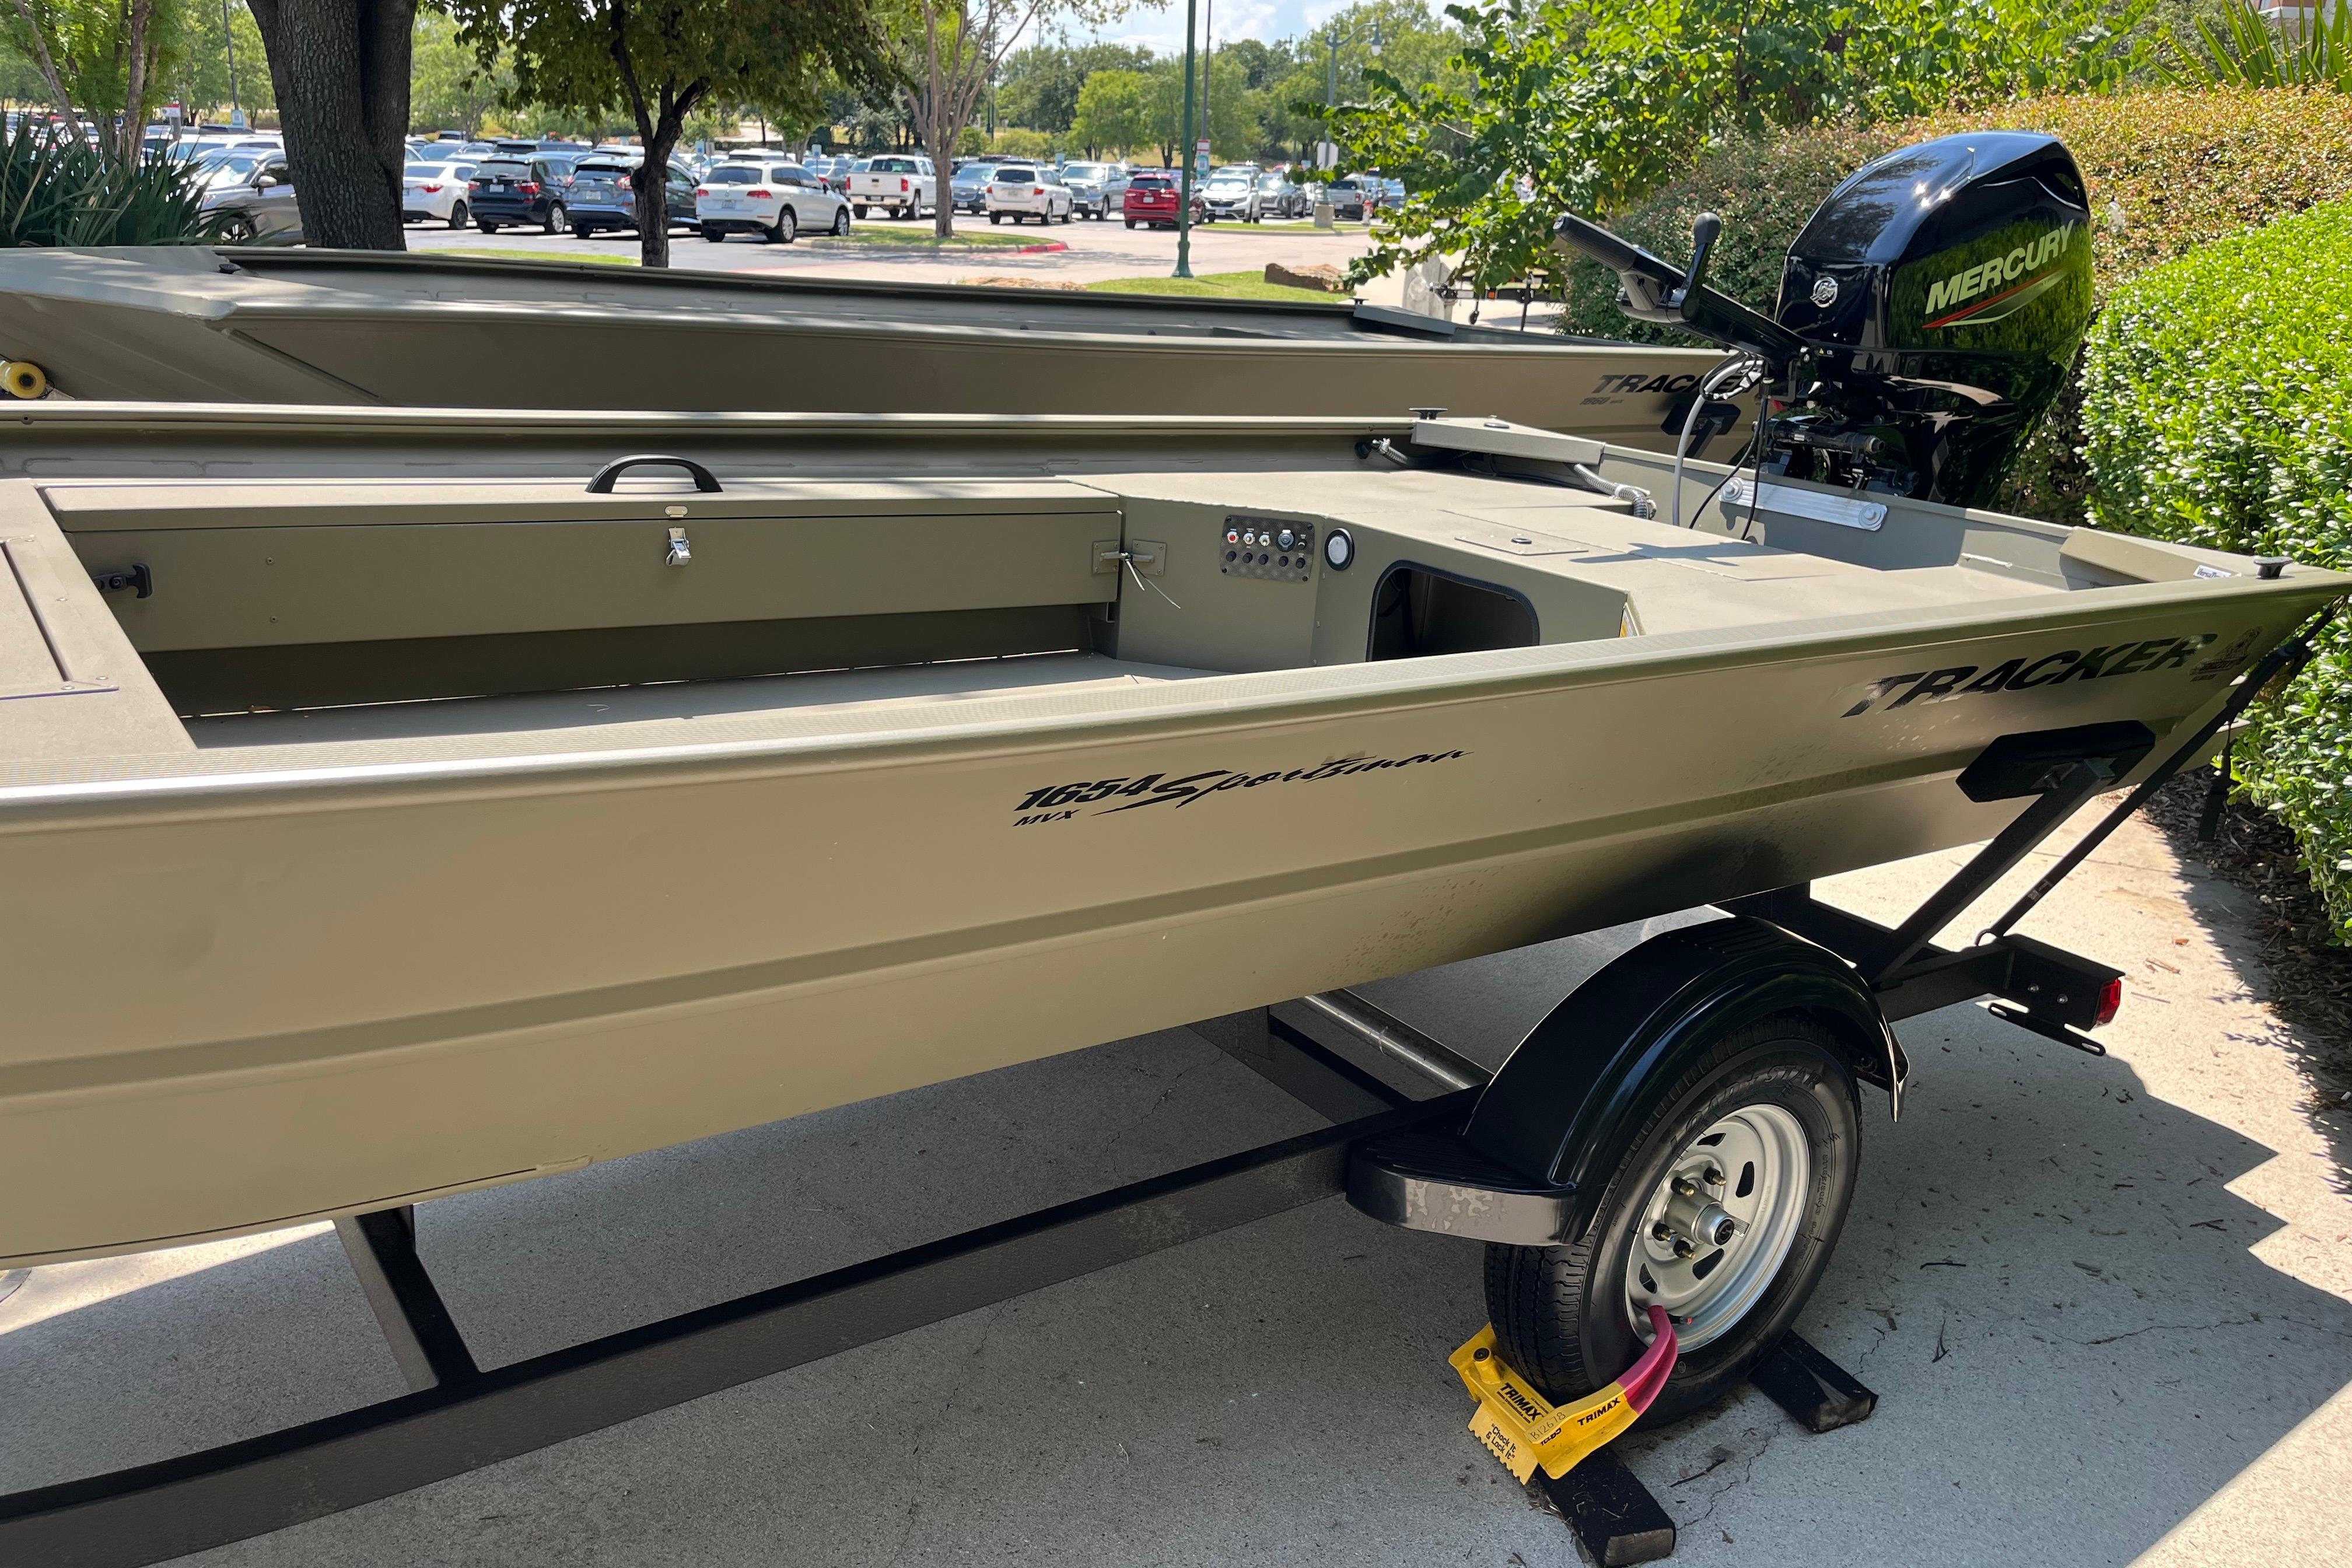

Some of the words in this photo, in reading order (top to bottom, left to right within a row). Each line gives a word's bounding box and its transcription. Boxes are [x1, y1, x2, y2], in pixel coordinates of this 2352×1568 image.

[1925, 220, 2074, 314] MERCURY
[1591, 374, 1752, 394] TRACE
[1840, 633, 2218, 719] TRACKER
[1013, 772, 1166, 811] 1654
[1090, 749, 1474, 816] Sportsman
[1012, 808, 1082, 827] MVX
[1500, 1382, 1543, 1422] TRIMAX
[1577, 1398, 1621, 1426] TRIMAX
[1486, 1432, 1492, 1440] &
[1491, 1436, 1506, 1454] Lock
